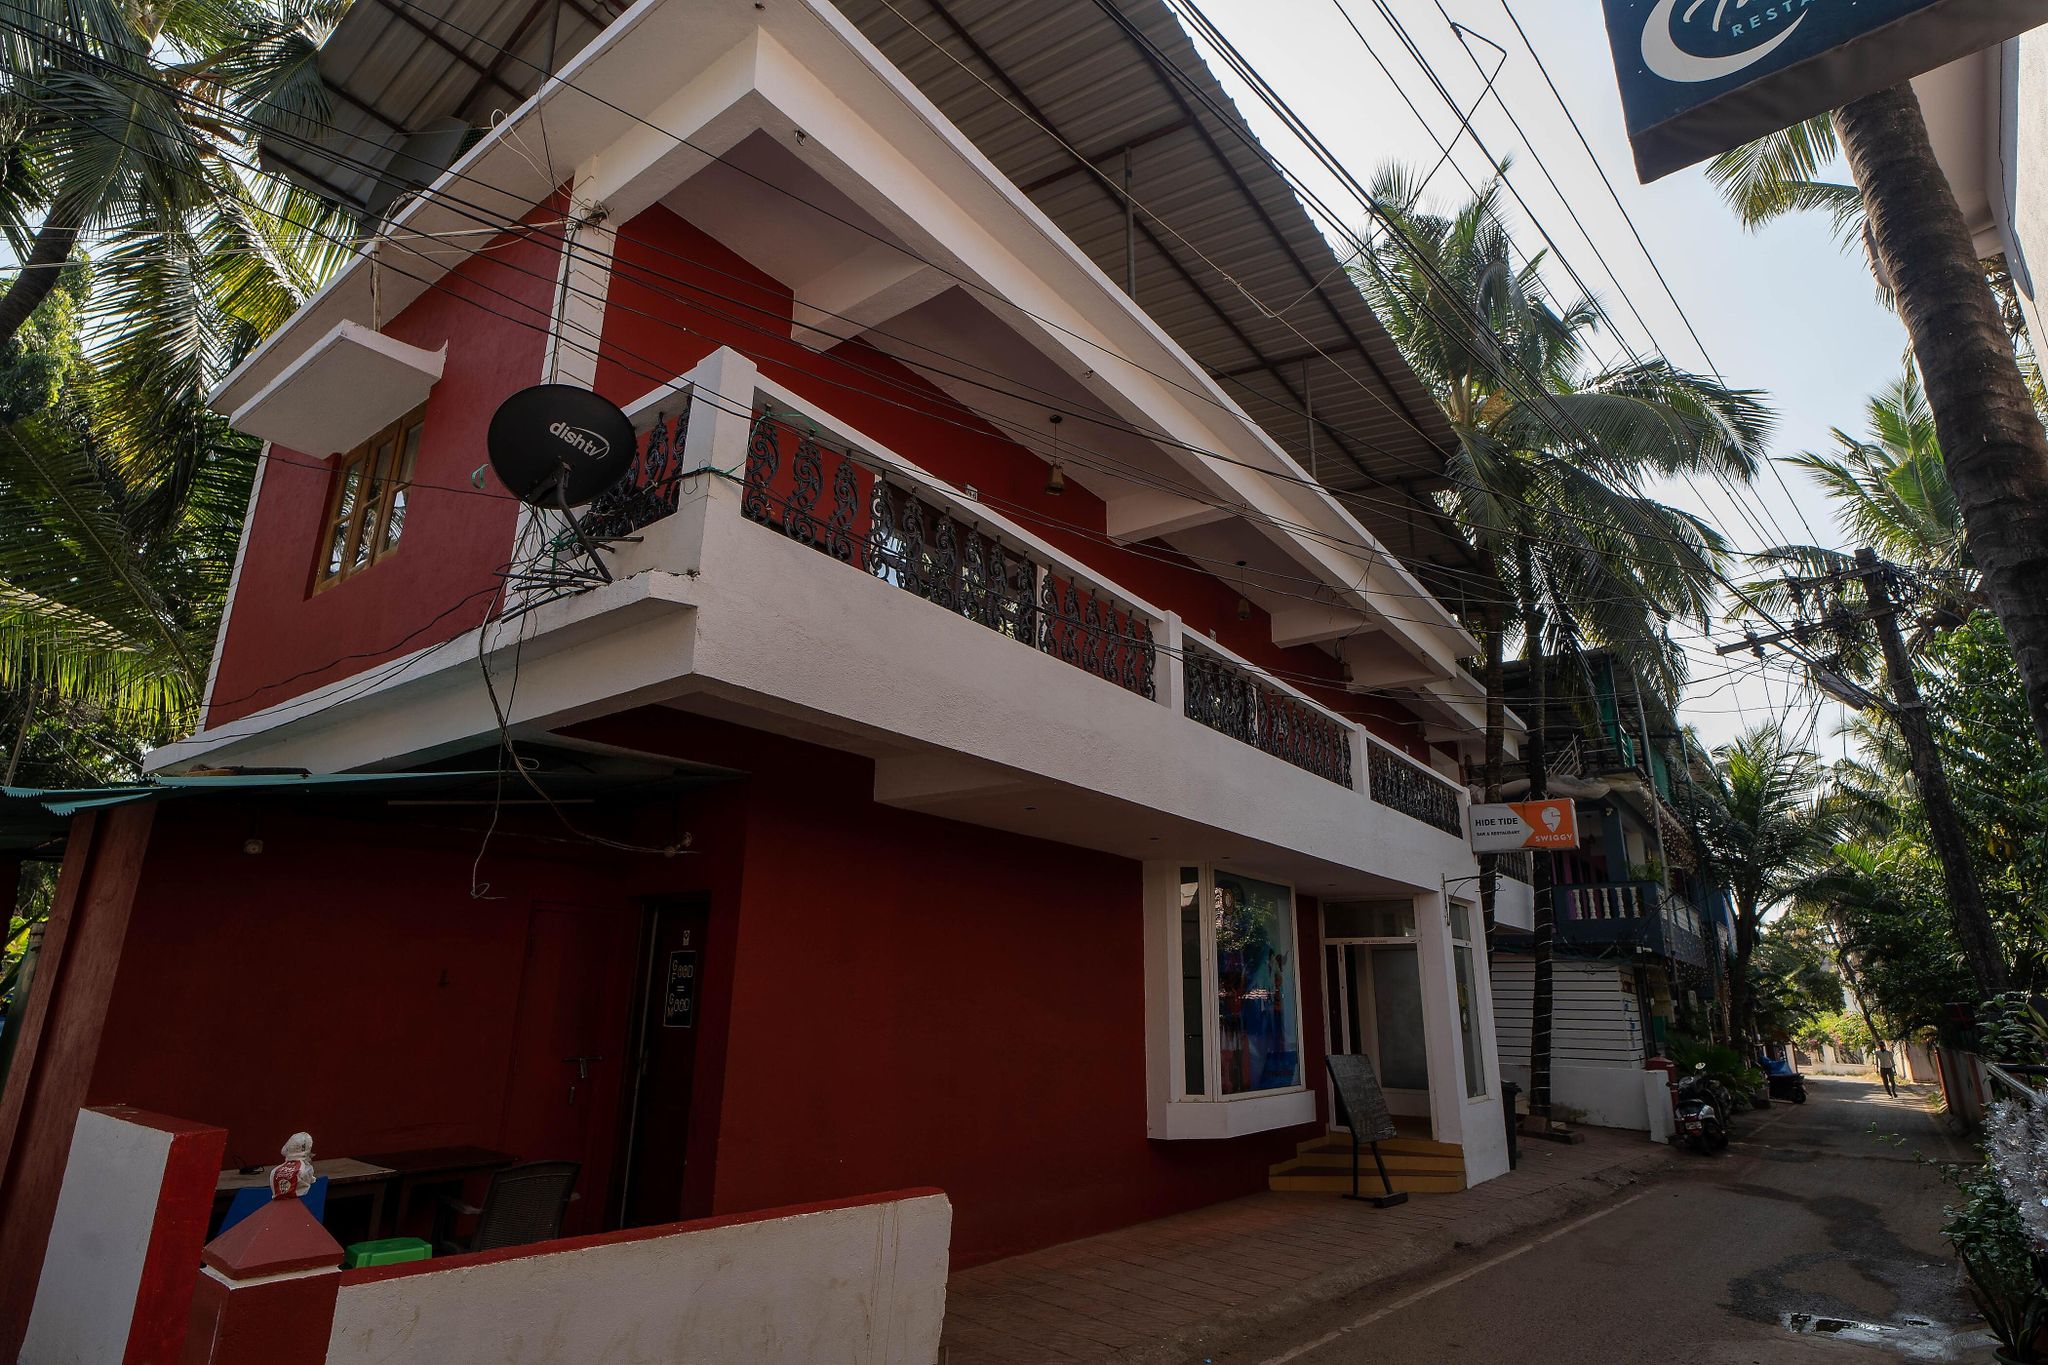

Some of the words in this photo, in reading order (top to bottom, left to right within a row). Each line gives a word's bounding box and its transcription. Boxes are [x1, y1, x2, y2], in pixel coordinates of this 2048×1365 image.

[549, 421, 606, 458] dishtv
[1475, 818, 1496, 827] HIDE
[1497, 817, 1518, 826] TIDE
[1535, 833, 1573, 842] SWIGGY
